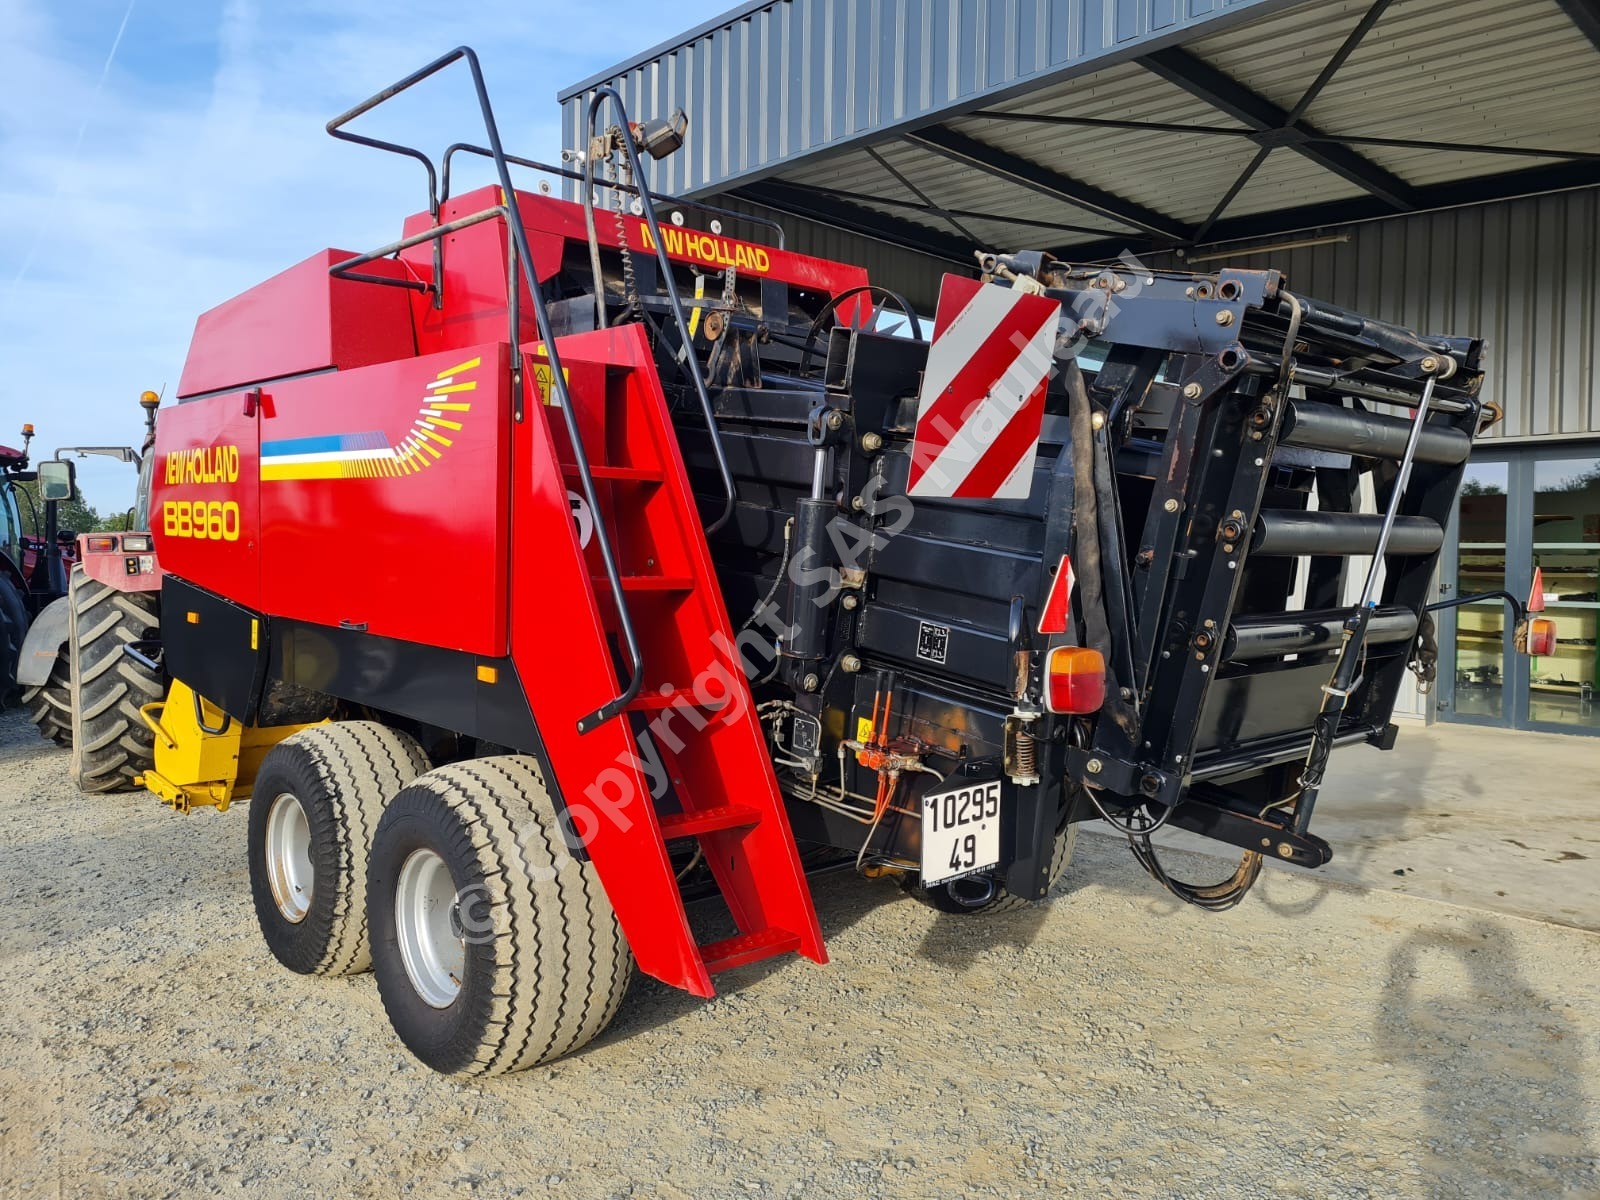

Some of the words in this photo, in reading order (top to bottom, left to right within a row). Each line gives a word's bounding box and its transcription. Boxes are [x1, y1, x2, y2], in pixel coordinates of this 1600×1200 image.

[640, 223, 683, 256] NW
[685, 232, 770, 273] HOLLAND
[164, 449, 187, 485] NEW
[185, 445, 239, 485] HOLLAND
[163, 501, 240, 542] BB960
[929, 785, 998, 832] 10295
[949, 834, 976, 872] 49
